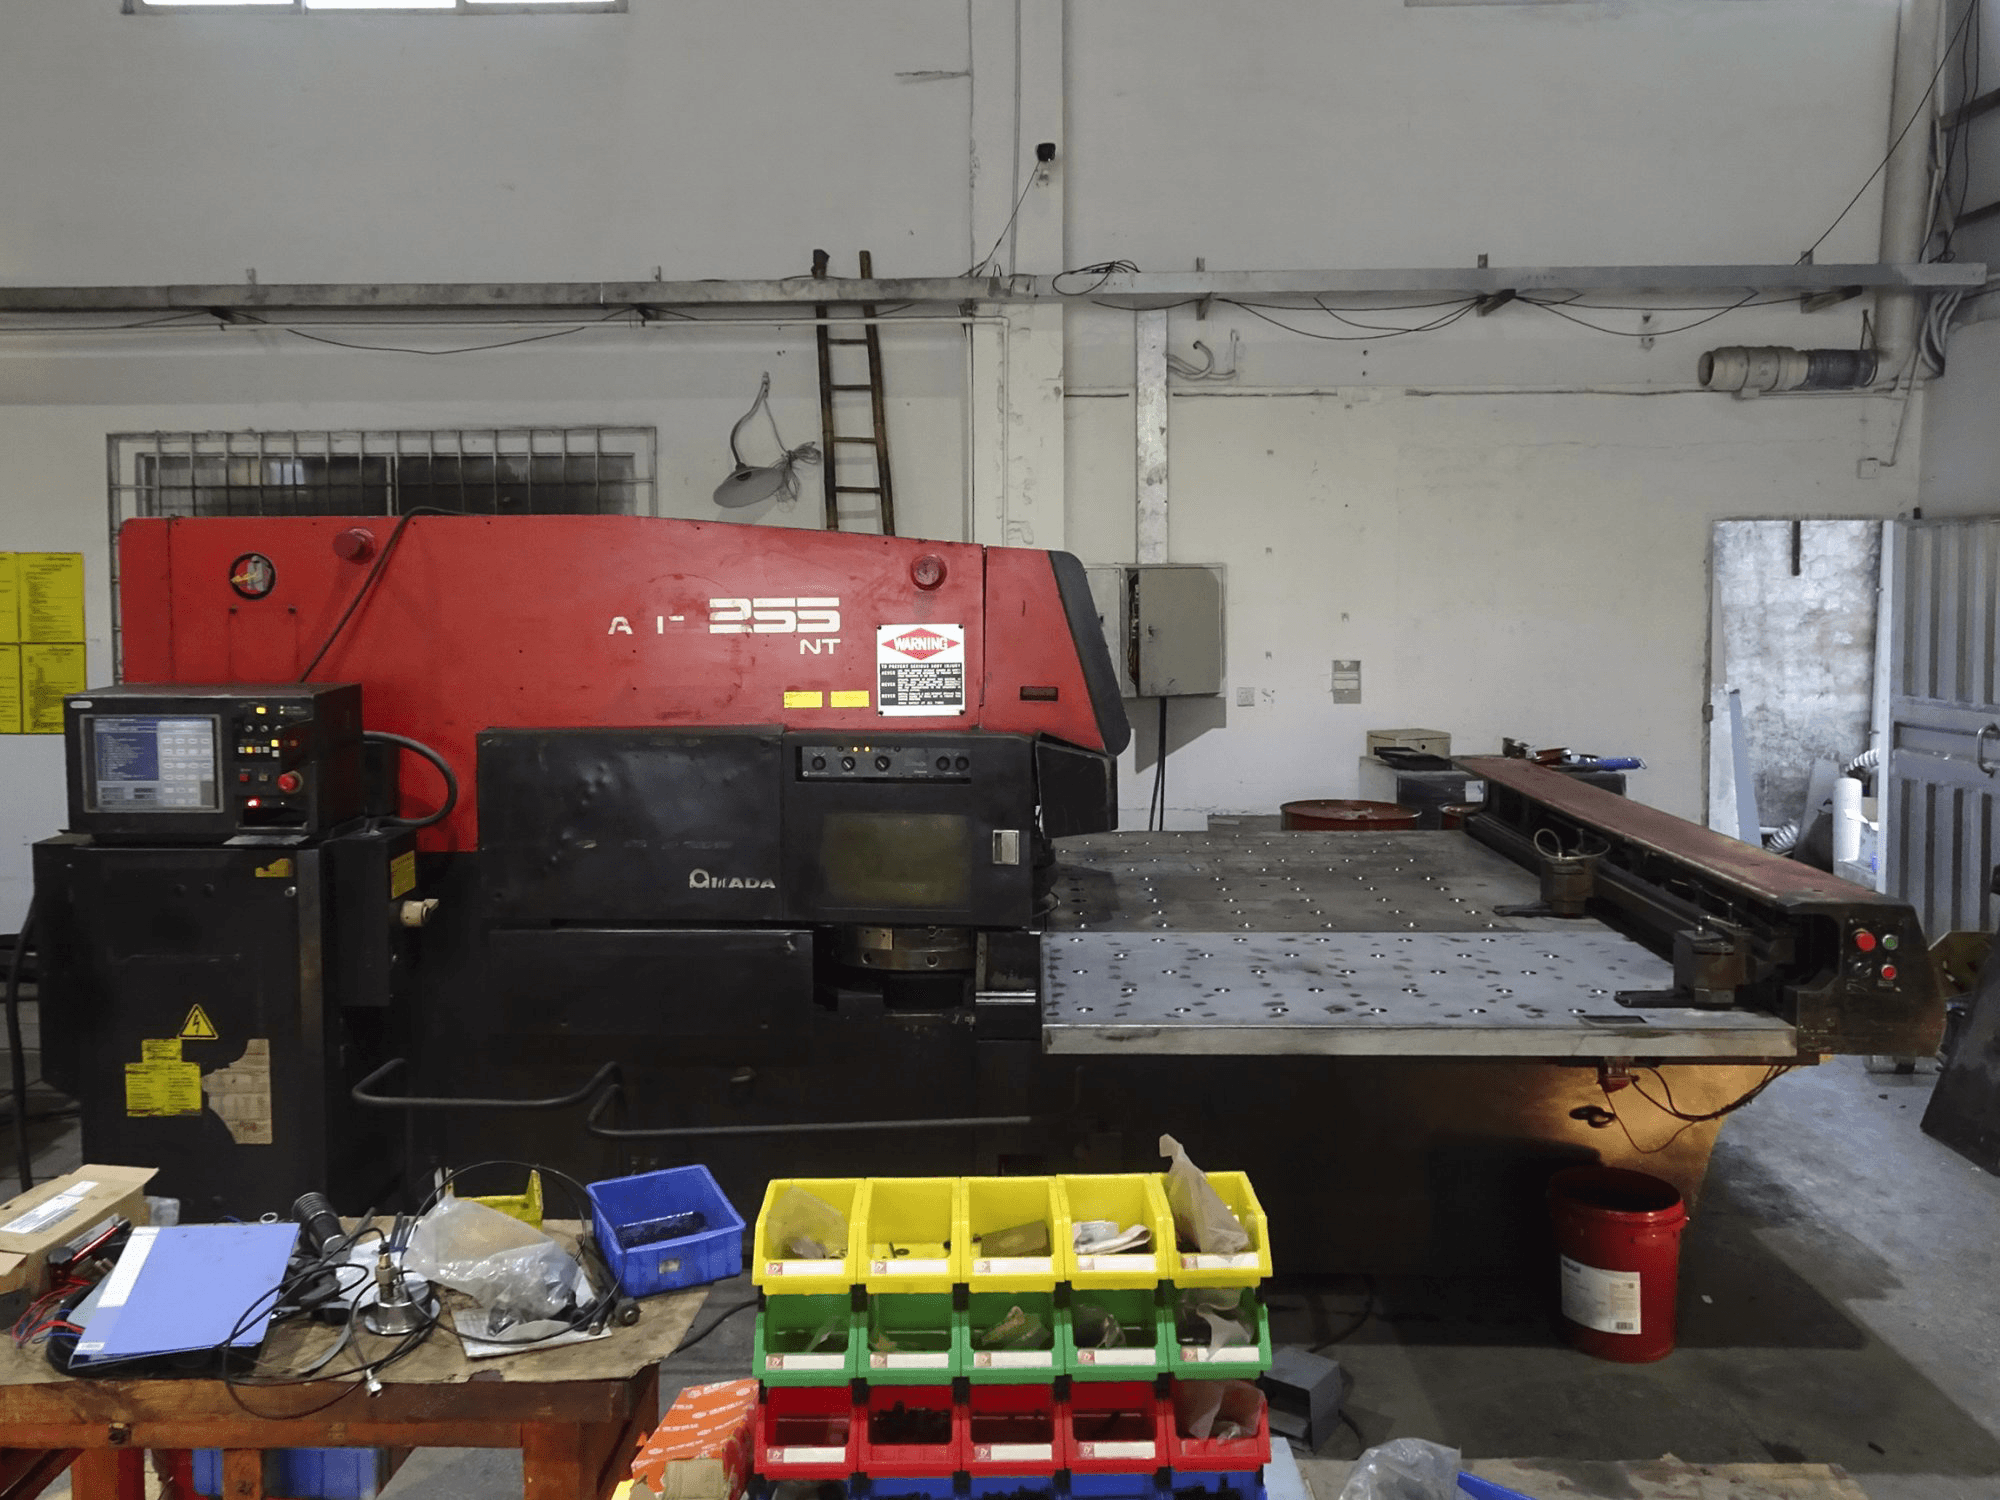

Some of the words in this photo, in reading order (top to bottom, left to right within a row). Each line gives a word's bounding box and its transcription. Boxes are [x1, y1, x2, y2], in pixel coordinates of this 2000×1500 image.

[709, 597, 841, 634] 255
[799, 638, 841, 655] NT
[895, 637, 948, 651] WARNING
